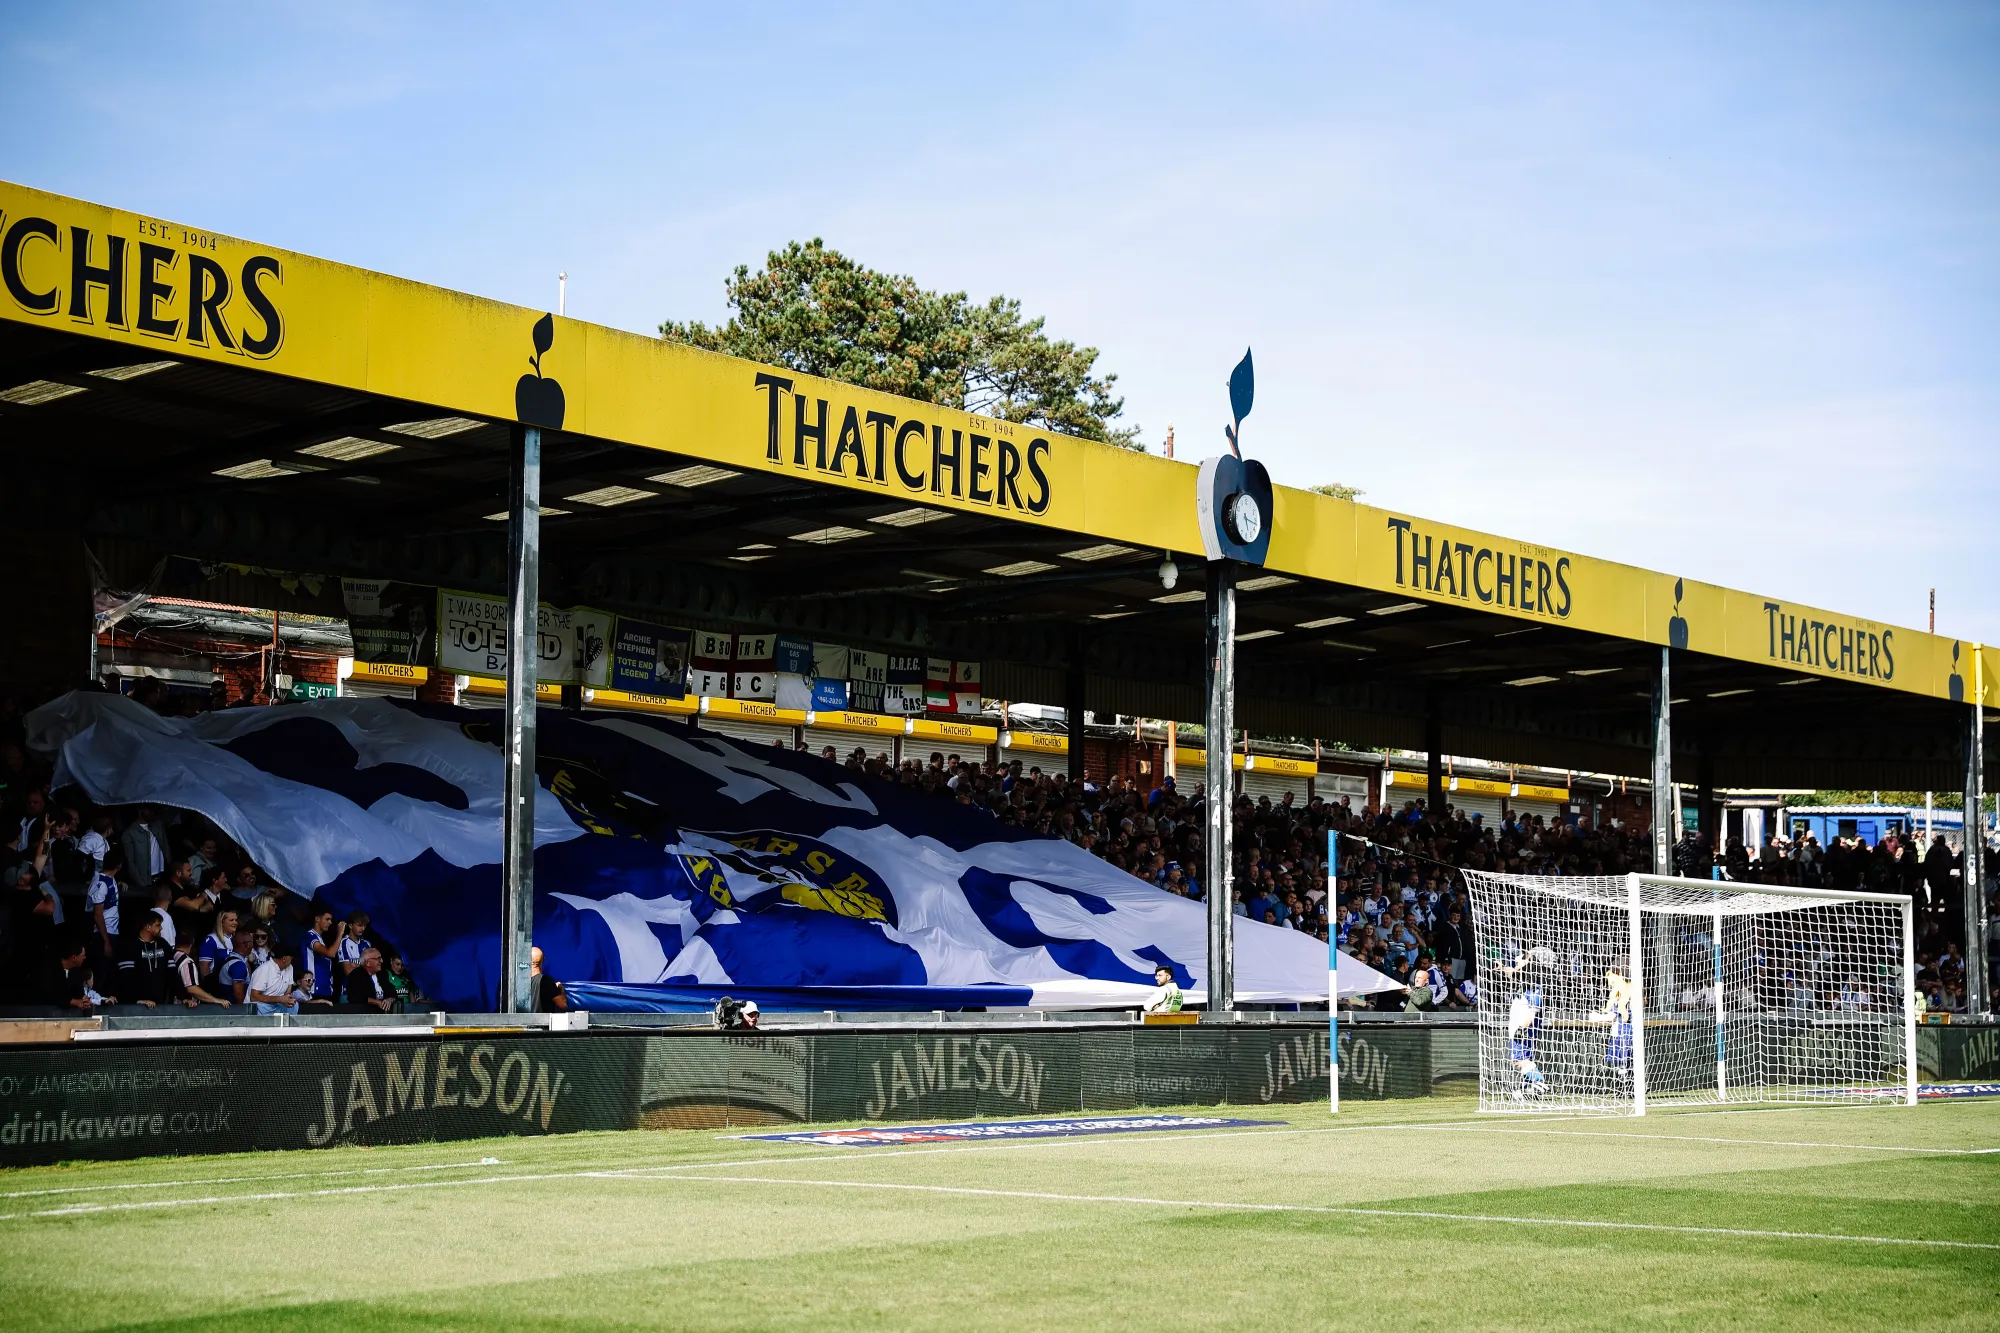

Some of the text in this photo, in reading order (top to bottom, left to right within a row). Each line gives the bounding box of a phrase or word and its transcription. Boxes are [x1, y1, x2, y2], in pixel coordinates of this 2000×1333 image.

[138, 219, 218, 252] EST. 1904
[0, 209, 285, 360] CHERS
[968, 416, 1014, 438] EST. 1904
[755, 372, 1052, 517] THATCHERS
[1534, 546, 1548, 558] 1904
[1387, 516, 1572, 620] THATCHERS
[456, 600, 481, 618] WAS
[552, 613, 571, 630] THE
[623, 632, 652, 645] ARCHIE
[780, 640, 809, 651] KEYNSHAM
[1763, 602, 1895, 683] THATCHERS
[617, 641, 656, 656] STEPHENS
[617, 656, 654, 670] TOTE END
[853, 651, 867, 667] WE
[890, 657, 920, 671] B.R.F.C.
[368, 662, 414, 678] THATCHERS
[620, 668, 649, 680] LEGEND
[866, 667, 883, 682] ARE
[308, 685, 332, 698] EXIT
[823, 686, 835, 694] BAZ
[852, 679, 884, 698] BARMY
[887, 685, 904, 699] THE
[740, 702, 777, 717] THATCHERS
[854, 695, 880, 712] ARMY
[902, 697, 920, 711] GAS
[843, 713, 878, 727] THATCHERS
[939, 723, 972, 738] THATCHERS
[1031, 734, 1062, 748] THATCHERS
[1272, 759, 1299, 771] THATCHERS
[1260, 1031, 1389, 1102] JAMESON
[30, 1072, 116, 1096] JAMESON
[119, 1067, 237, 1092] RESPONSIBLY
[865, 1038, 1046, 1119] JAMESON
[306, 1041, 565, 1147] JAMESON
[0, 1101, 232, 1145] drinkaware.co.uk
